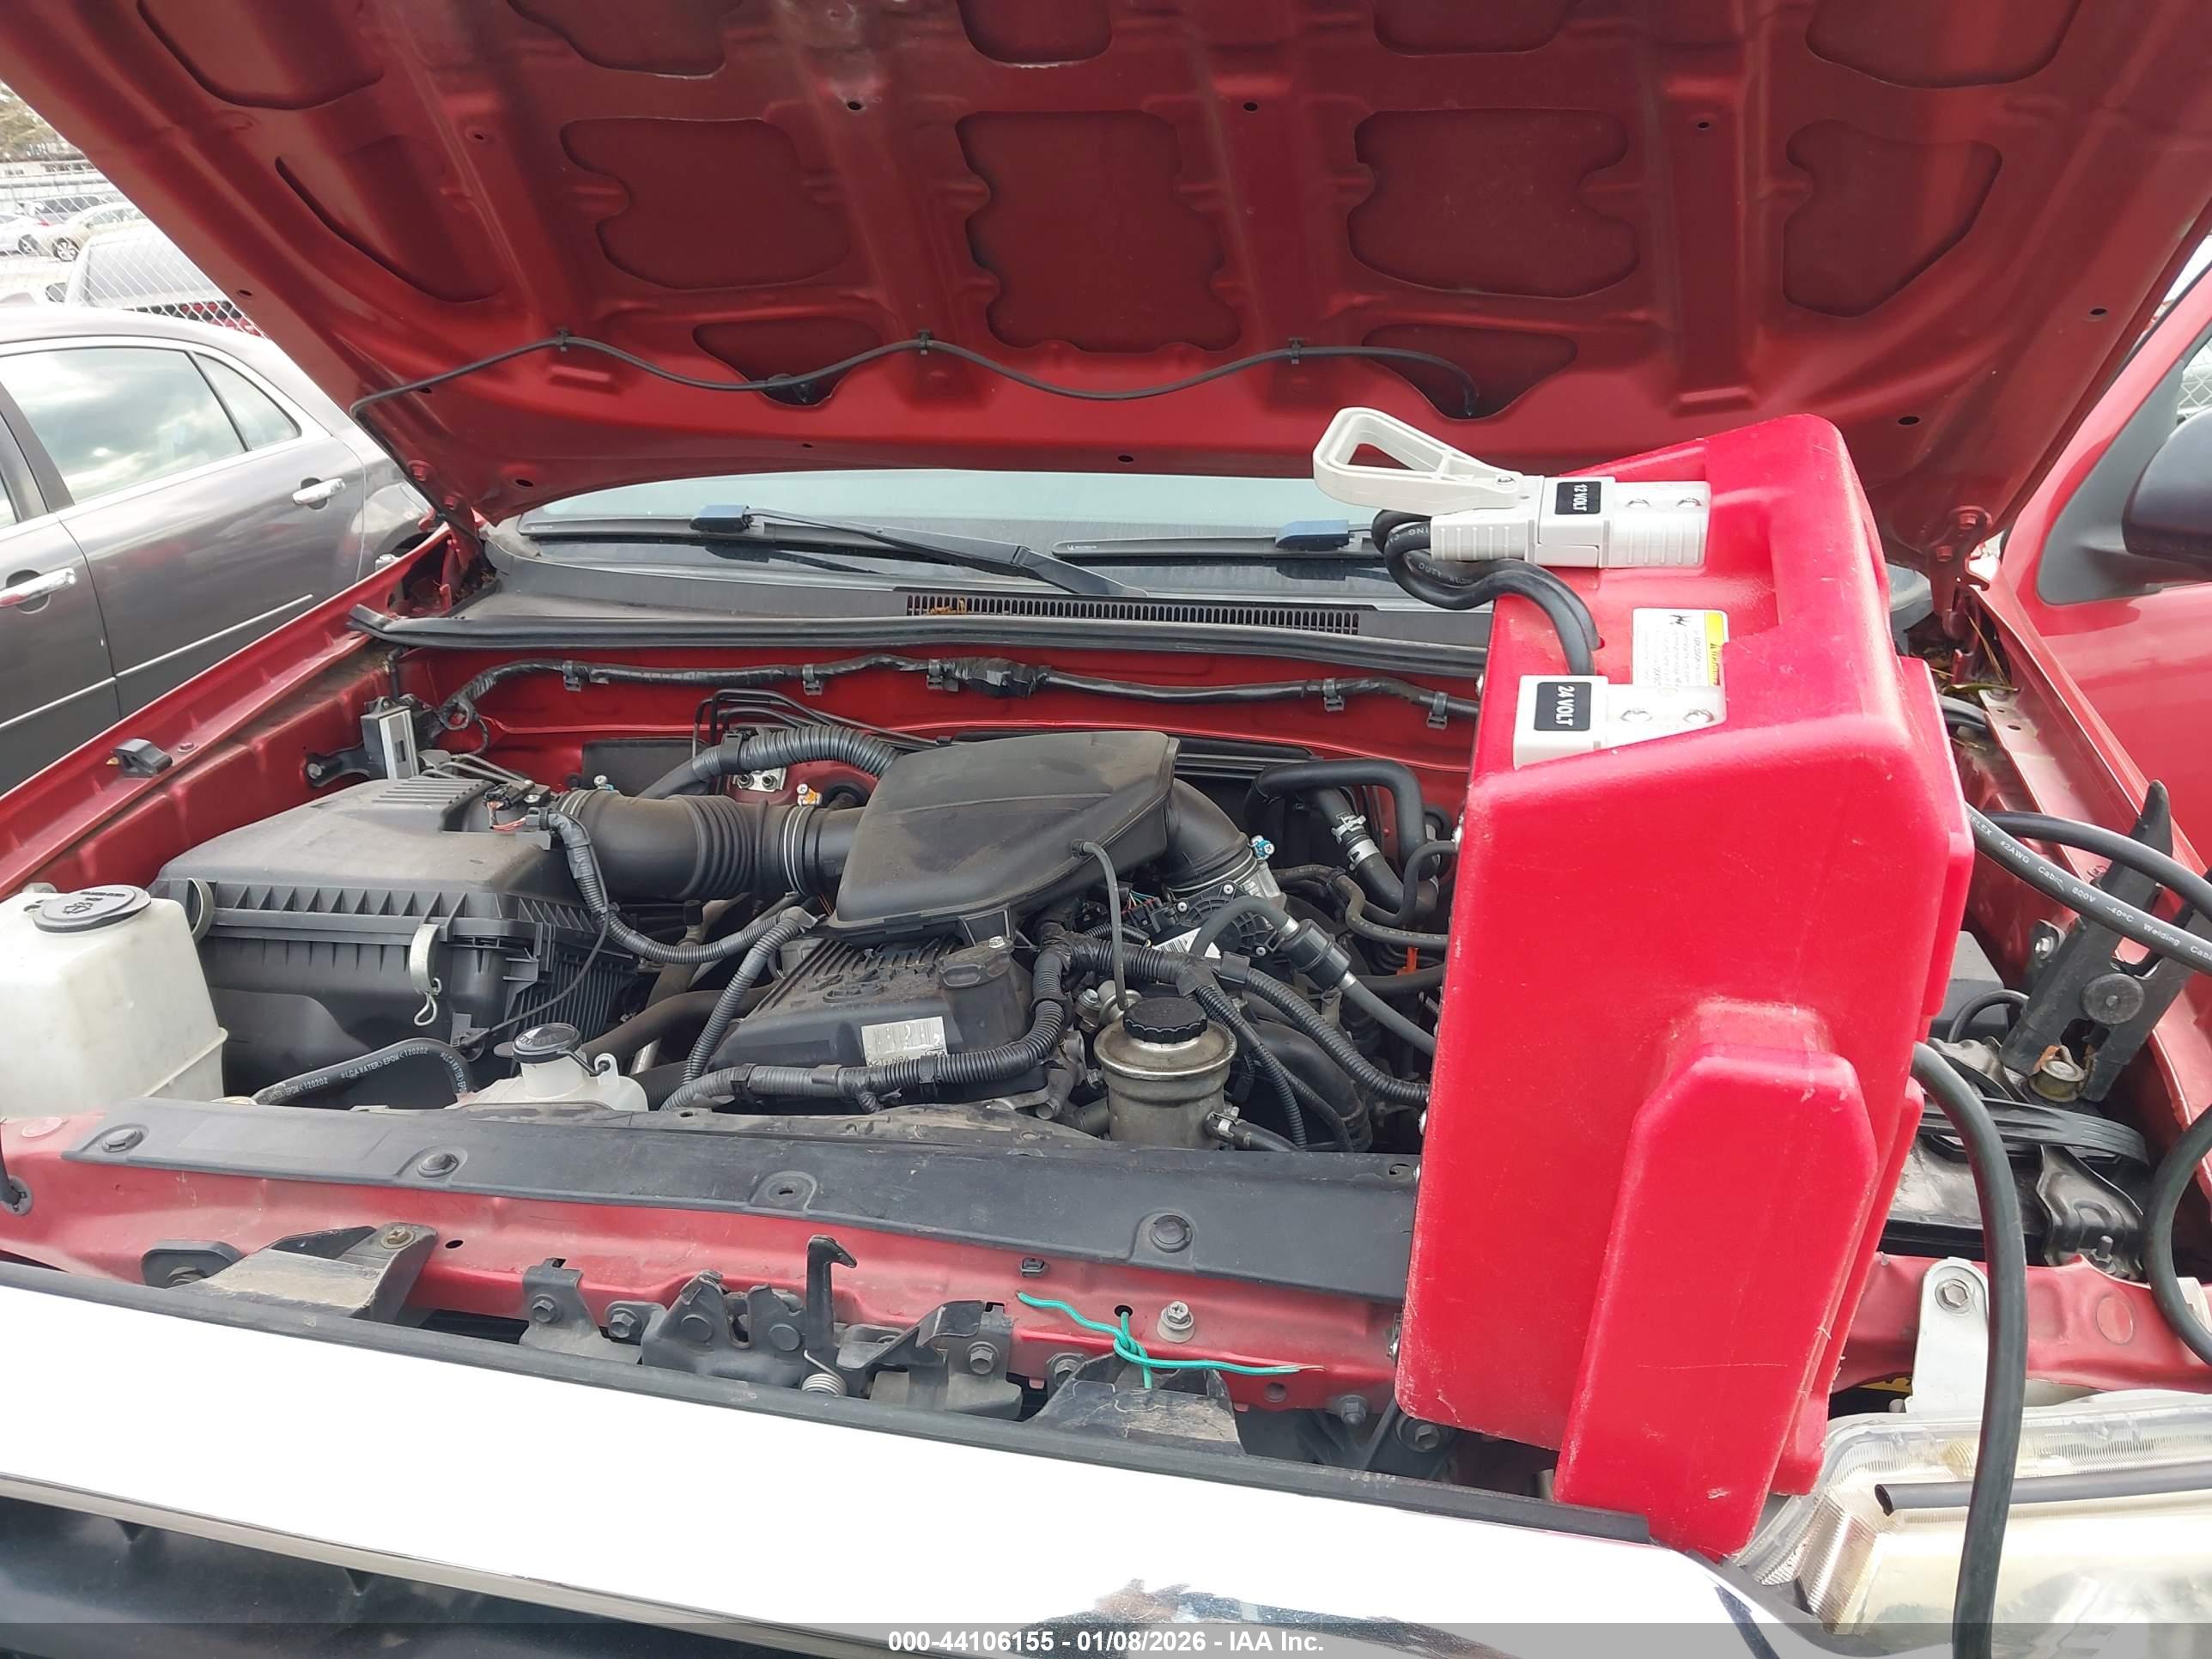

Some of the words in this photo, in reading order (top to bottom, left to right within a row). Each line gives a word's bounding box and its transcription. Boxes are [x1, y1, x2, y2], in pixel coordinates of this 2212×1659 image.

[1572, 493, 1588, 512] VOLT
[1418, 562, 1442, 578] DUTY
[1557, 685, 1575, 697] 24
[1555, 699, 1575, 726] VOLT
[2143, 922, 2181, 947] Welding
